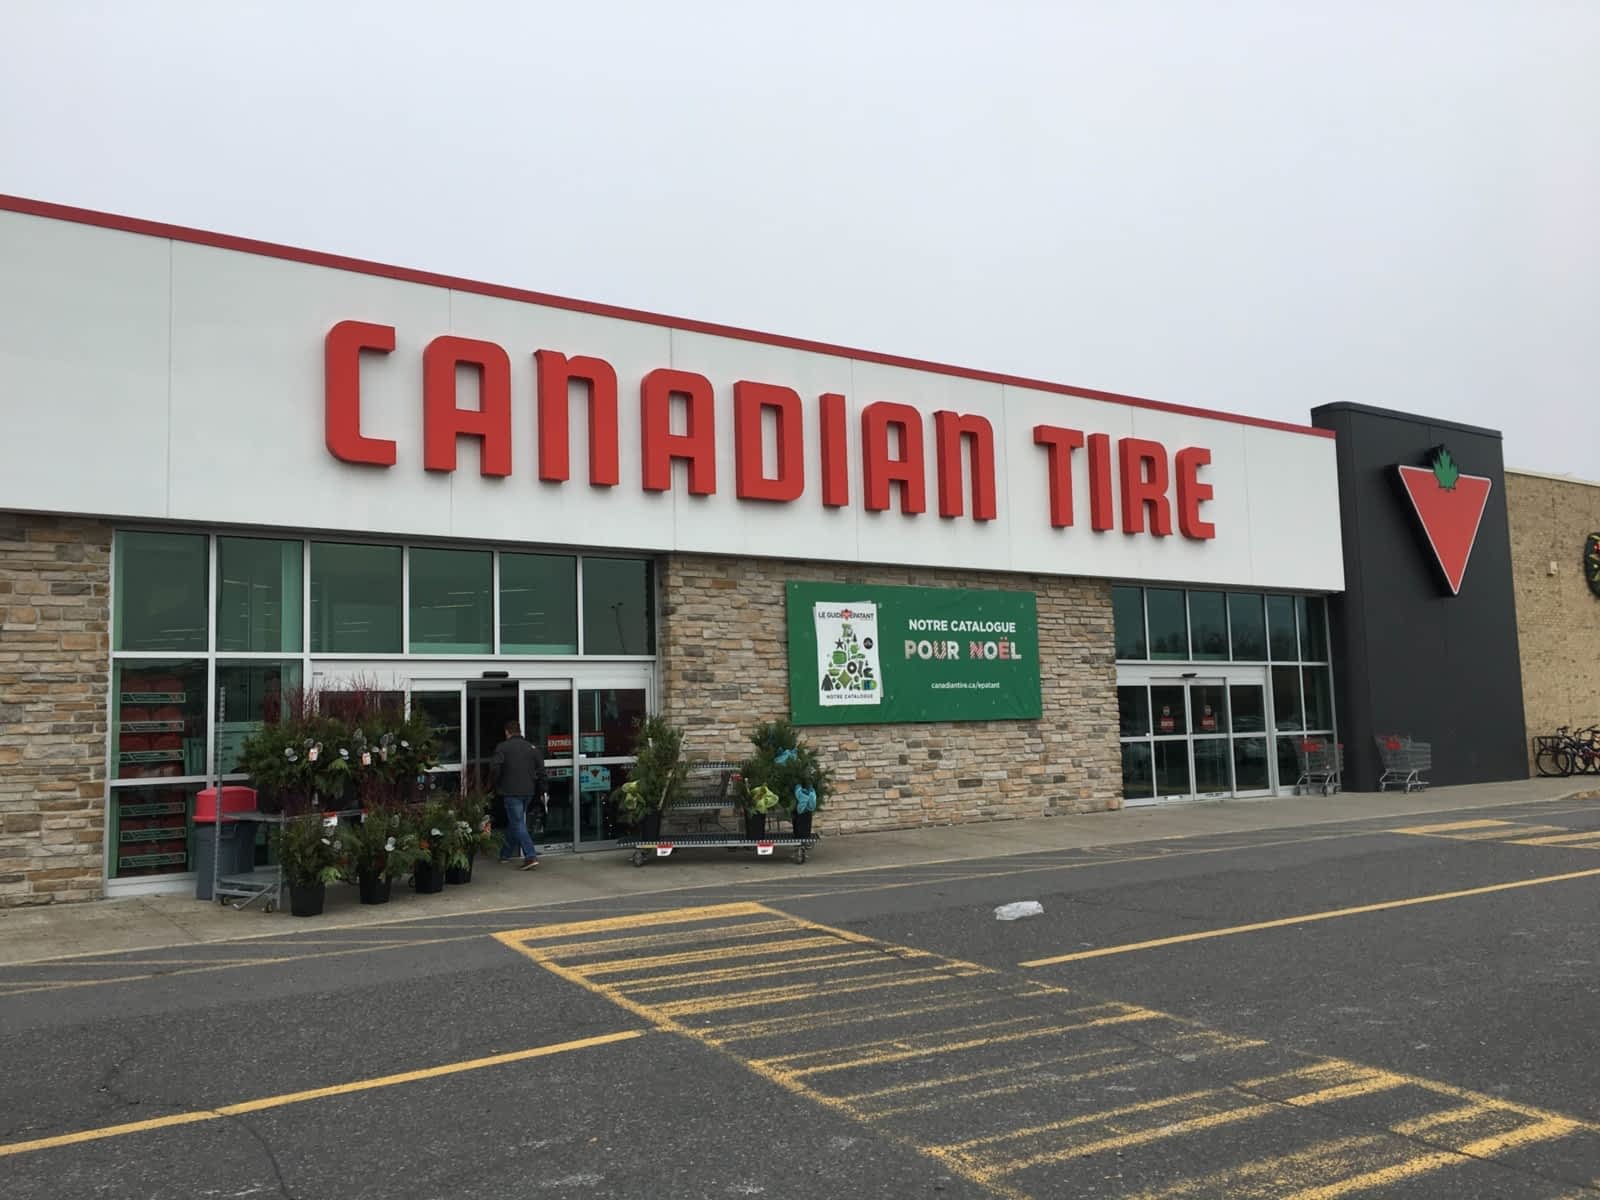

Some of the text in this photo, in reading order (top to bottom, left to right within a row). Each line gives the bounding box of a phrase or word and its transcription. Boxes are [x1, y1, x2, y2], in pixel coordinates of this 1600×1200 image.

[325, 319, 1216, 540] CANADIAN TIRE
[908, 619, 1016, 633] NOTRE CATALOGUE
[904, 636, 1022, 660] POUR NOËL
